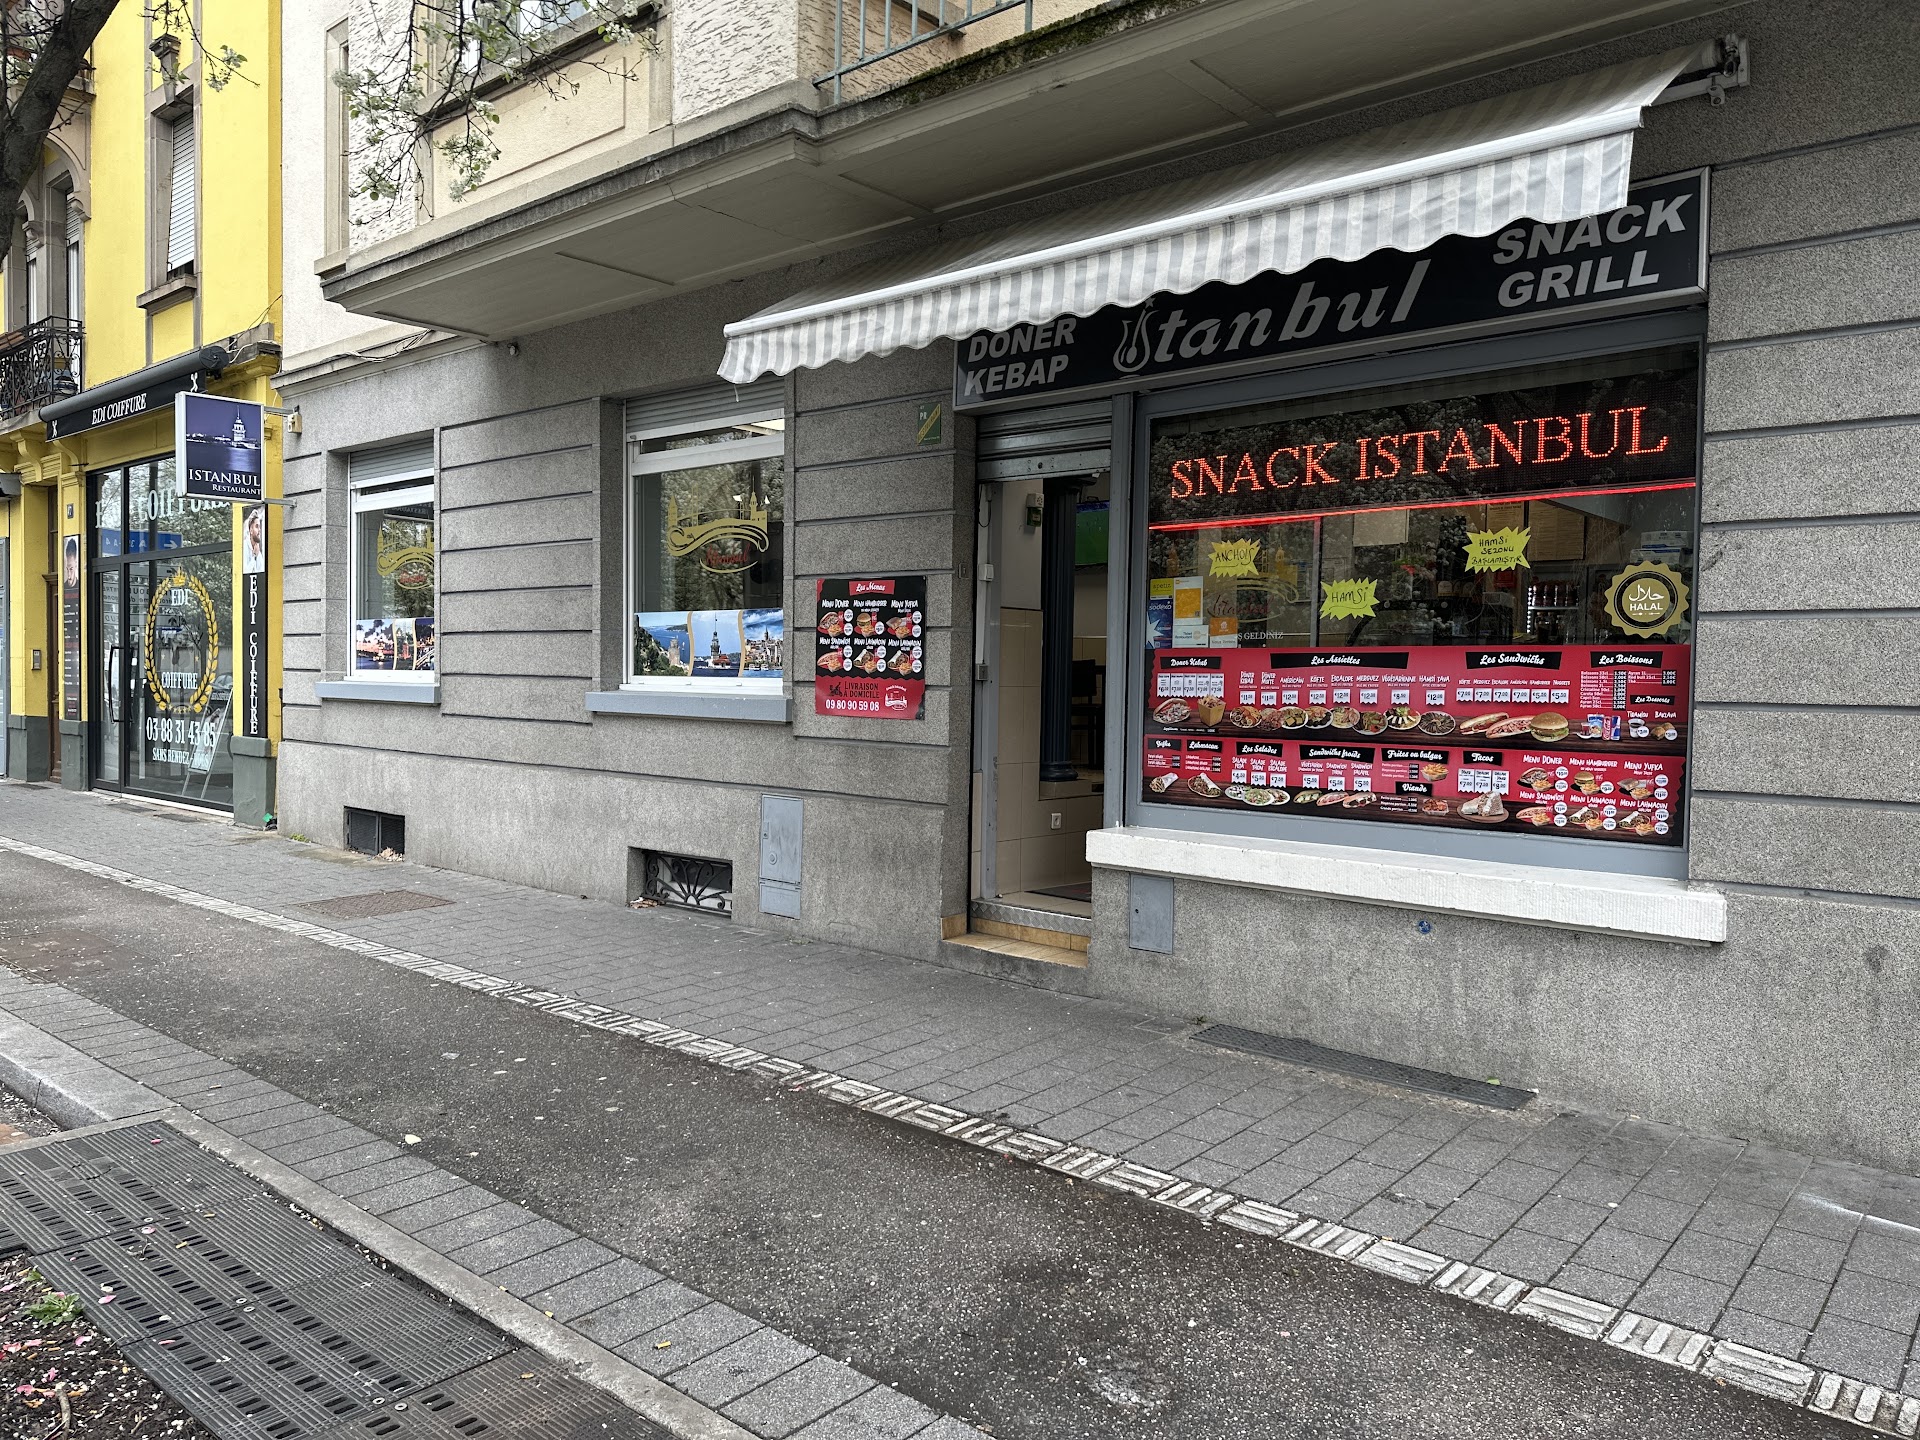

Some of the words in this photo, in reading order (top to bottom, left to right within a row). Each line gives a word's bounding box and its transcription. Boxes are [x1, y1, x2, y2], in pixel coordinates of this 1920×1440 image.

[1493, 193, 1693, 265] SNACK
[1498, 250, 1660, 308] GRILL
[963, 355, 1069, 396] KEBAP
[92, 405, 105, 425] EDI
[107, 393, 147, 420] COIFFURE
[1171, 442, 1340, 498] SNACK
[1355, 407, 1668, 480] ISTANBUL
[189, 468, 261, 487] ISTANBUL
[171, 588, 191, 606] EDI
[1628, 584, 1665, 601] حلال
[1630, 603, 1663, 611] HALAL
[1311, 656, 1324, 665] Les
[1326, 655, 1360, 665] Assiettes
[1480, 655, 1496, 665] Les
[1599, 655, 1614, 665] Les
[1616, 654, 1653, 665] Boissons
[162, 672, 198, 689] COIFFURE
[845, 681, 878, 691] LIVRAISON
[850, 690, 879, 698] DOMICILE
[826, 699, 835, 709] 09
[836, 700, 846, 710] 80
[848, 700, 857, 710] 90
[858, 700, 868, 710] 59
[870, 701, 879, 711] 08
[146, 717, 158, 741] 03
[161, 718, 173, 743] 88
[175, 720, 185, 744] 31
[188, 721, 200, 745] 43
[203, 722, 216, 747] 85
[153, 748, 167, 762] SANS
[1242, 745, 1253, 753] Les
[1254, 745, 1277, 754] Salades
[1387, 750, 1408, 759] Frites
[1472, 753, 1494, 762] Tacos
[1523, 755, 1540, 763] MENU
[1569, 758, 1585, 766] MENU
[1586, 759, 1617, 768] HAMBURGER
[1624, 761, 1642, 770] MENU
[1644, 762, 1663, 771] YUFKA
[1402, 783, 1427, 792] Viande
[1520, 791, 1535, 799] MENU
[1570, 794, 1585, 803] MENU
[1586, 796, 1616, 805] LAHMACUN
[1620, 798, 1636, 807] MENU
[1637, 800, 1668, 810] LAHMACUN
